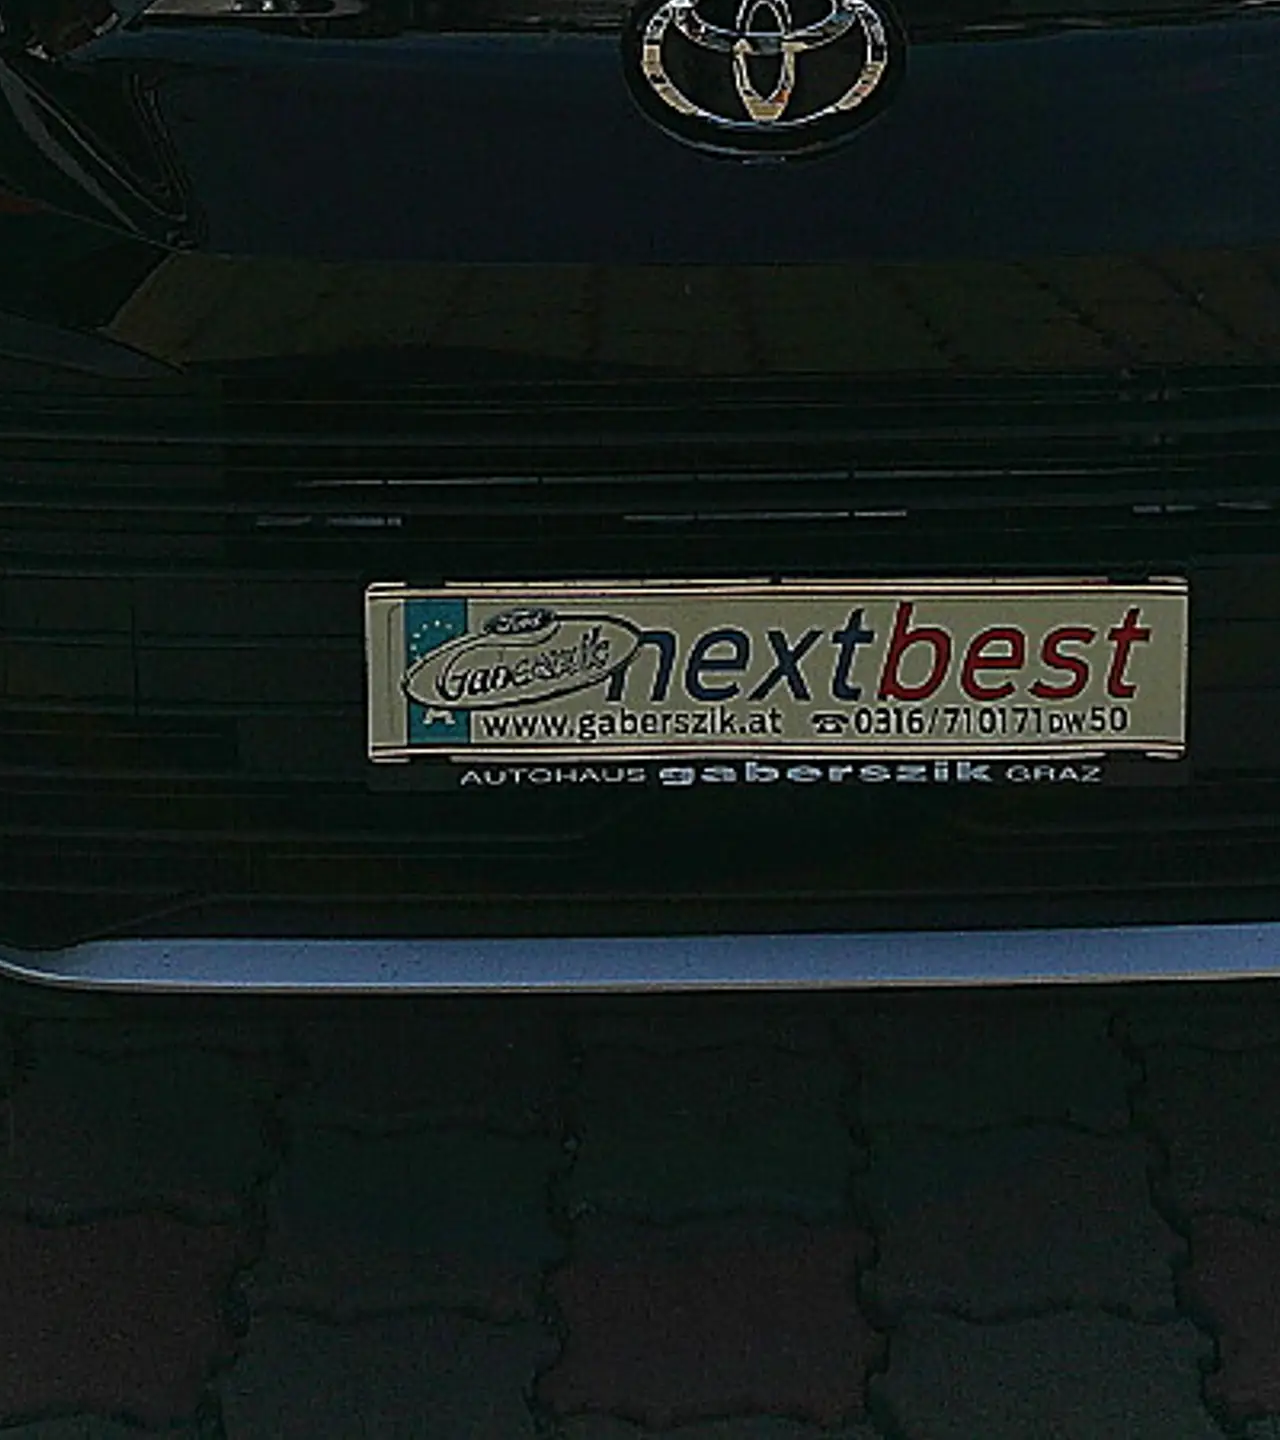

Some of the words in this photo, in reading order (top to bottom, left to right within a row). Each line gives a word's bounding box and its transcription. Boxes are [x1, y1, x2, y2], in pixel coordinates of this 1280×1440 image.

[603, 602, 1151, 702] nextbest
[482, 708, 783, 740] www.gaberszik.at
[461, 767, 646, 785] AUTOHAUS
[659, 761, 993, 785] gaberszik
[1005, 765, 1103, 783] GRAZ
